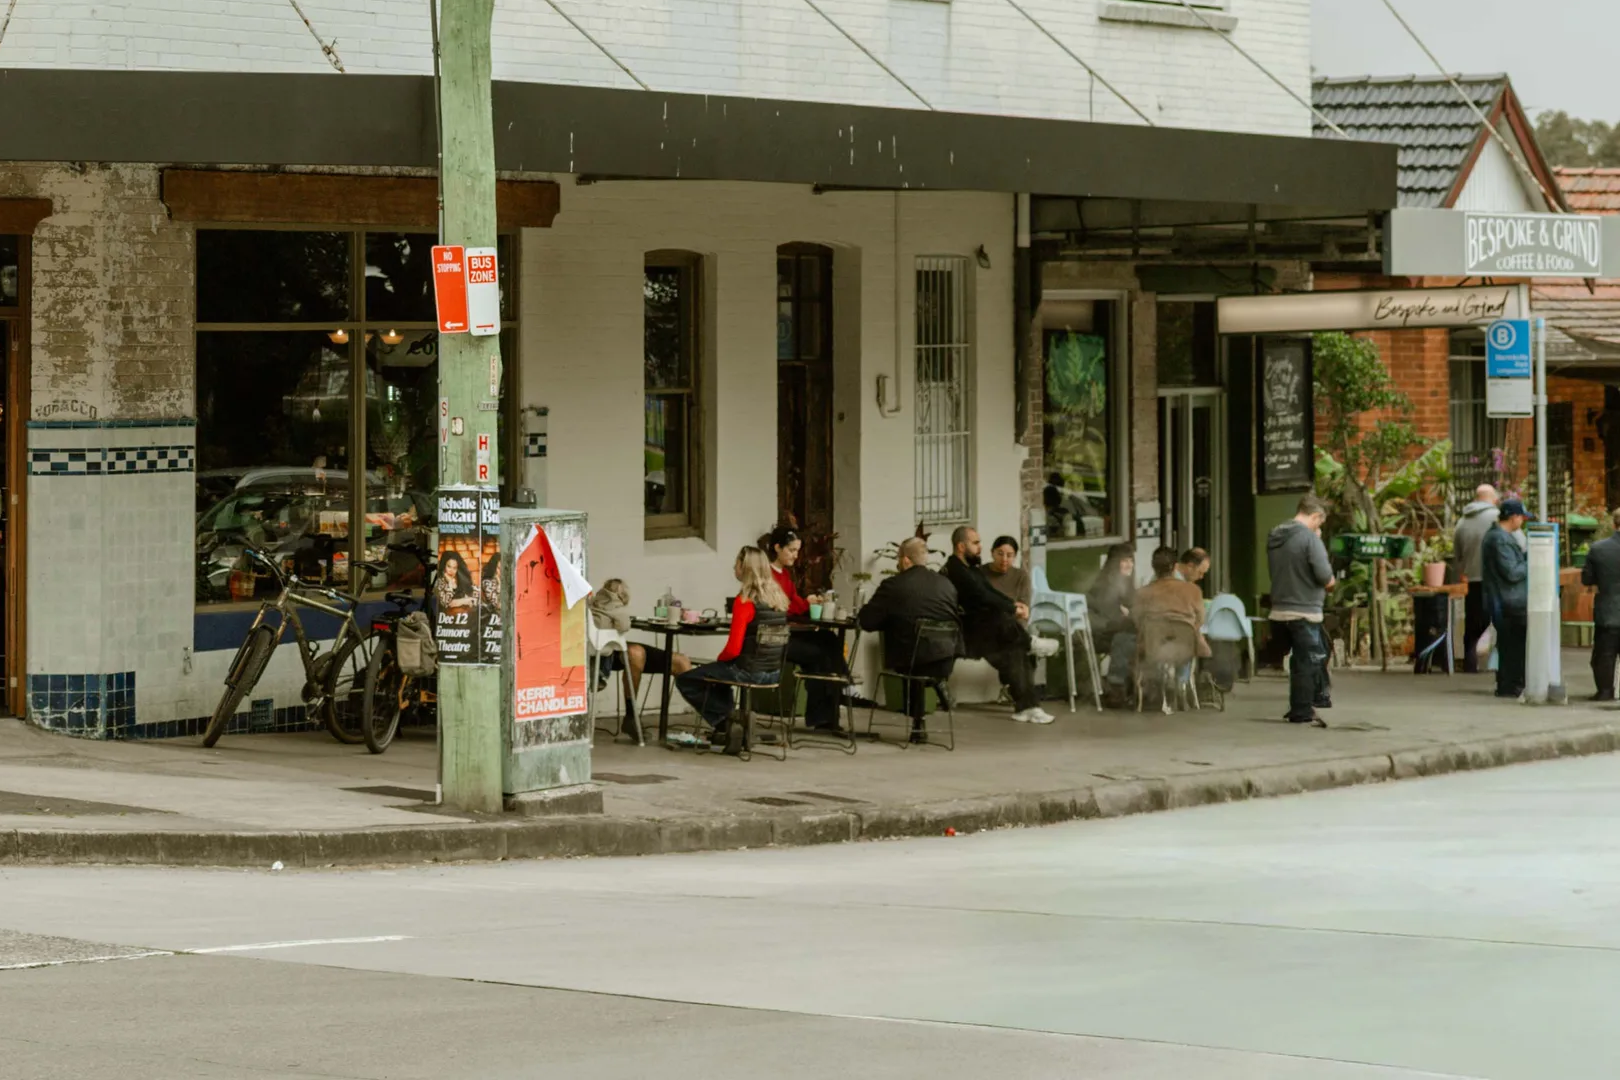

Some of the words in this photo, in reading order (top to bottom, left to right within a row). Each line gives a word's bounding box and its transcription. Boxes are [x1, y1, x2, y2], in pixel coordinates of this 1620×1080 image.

[1468, 218, 1535, 269] BESPOKE
[1539, 219, 1549, 247] &
[1553, 219, 1598, 268] GRIND
[443, 251, 453, 261] NO
[471, 257, 492, 269] BUS
[1496, 253, 1532, 270] COFFEE
[1536, 253, 1545, 270] &
[1546, 254, 1575, 270] FOOD
[437, 263, 461, 273] STOPPING
[470, 270, 495, 282] ZONE
[1374, 296, 1438, 325] Bespoke
[1462, 290, 1510, 319] Grind
[441, 401, 447, 417] S
[441, 427, 447, 443] V
[478, 435, 488, 450] H
[479, 464, 488, 480] R
[438, 612, 454, 624] Dec
[455, 613, 468, 624] 12
[436, 625, 470, 637] Enmore
[437, 640, 471, 652] Theatre
[517, 685, 556, 701] KERRI
[517, 695, 584, 715] CHANDLER
